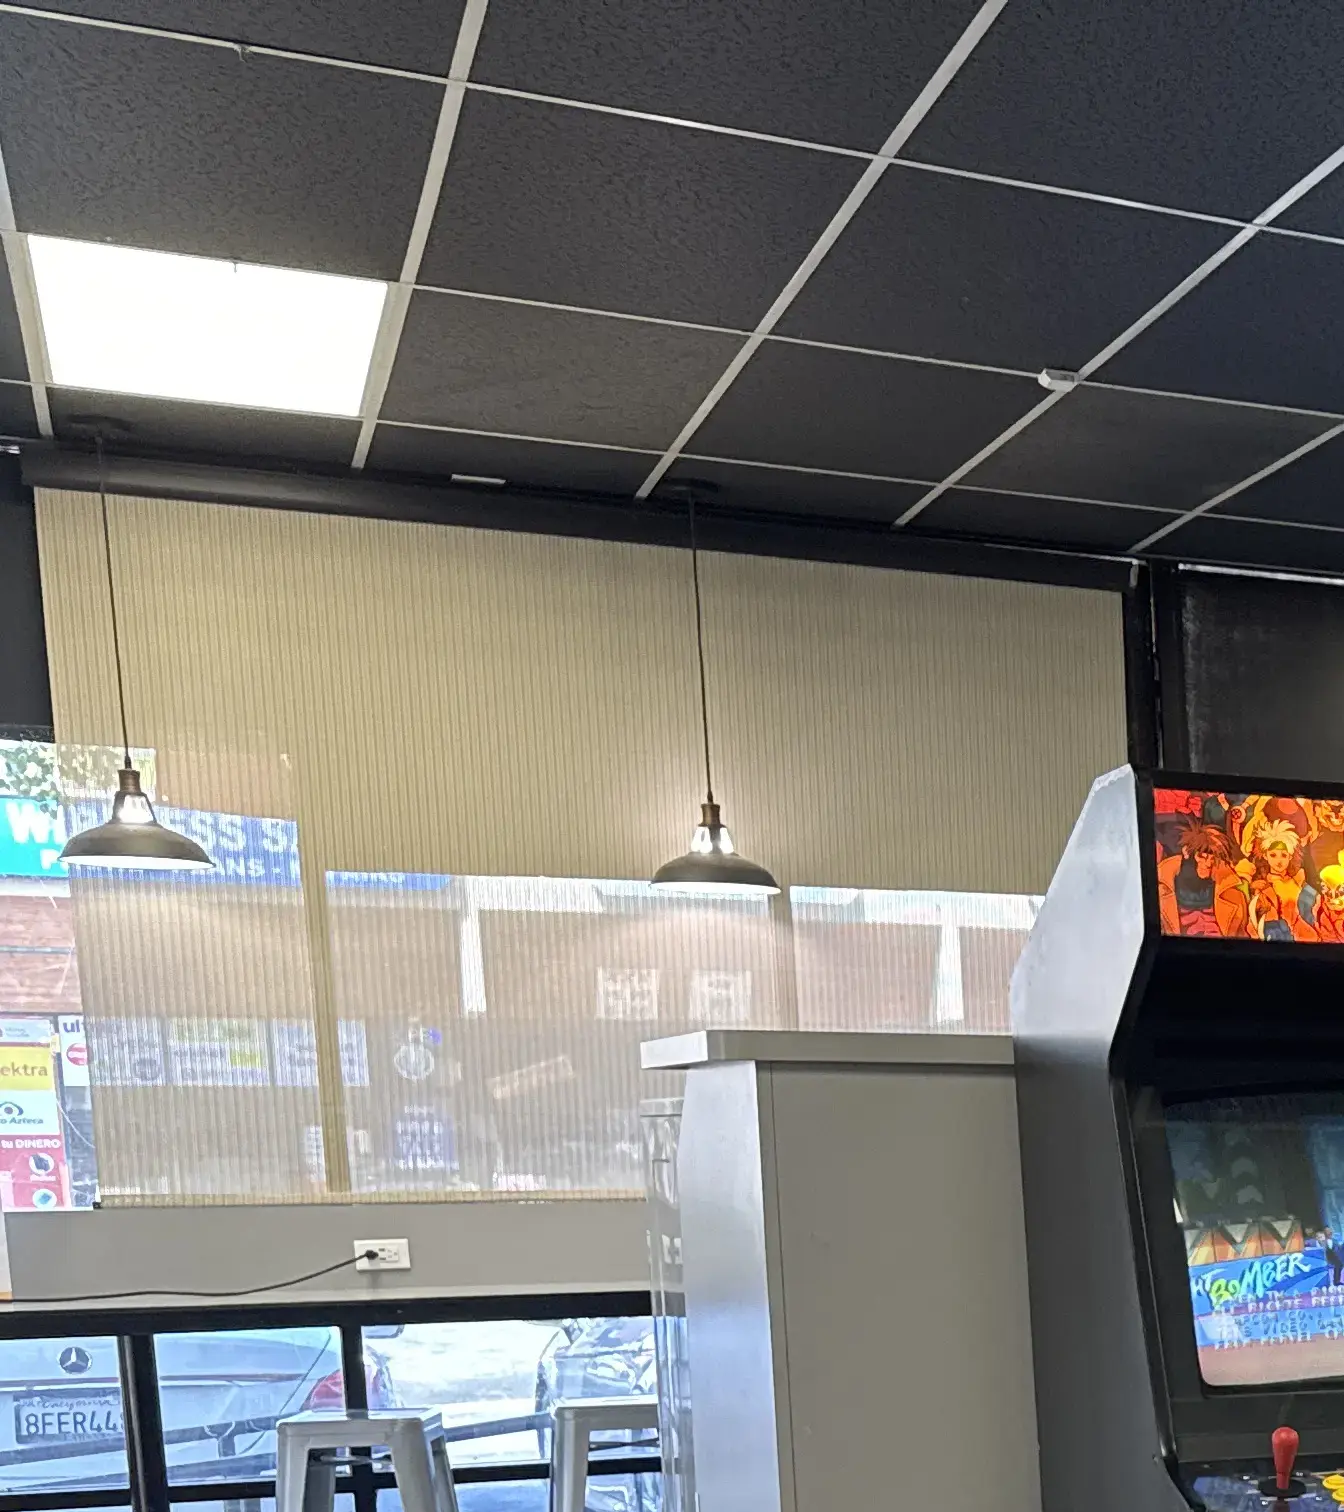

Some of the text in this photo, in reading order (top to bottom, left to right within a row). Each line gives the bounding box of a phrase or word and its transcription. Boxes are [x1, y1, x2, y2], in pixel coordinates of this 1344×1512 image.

[9, 1115, 44, 1125] Azteca
[15, 1139, 61, 1149] DINERO
[1210, 1252, 1312, 1307] BOMBER
[24, 1410, 125, 1437] 8FER44
